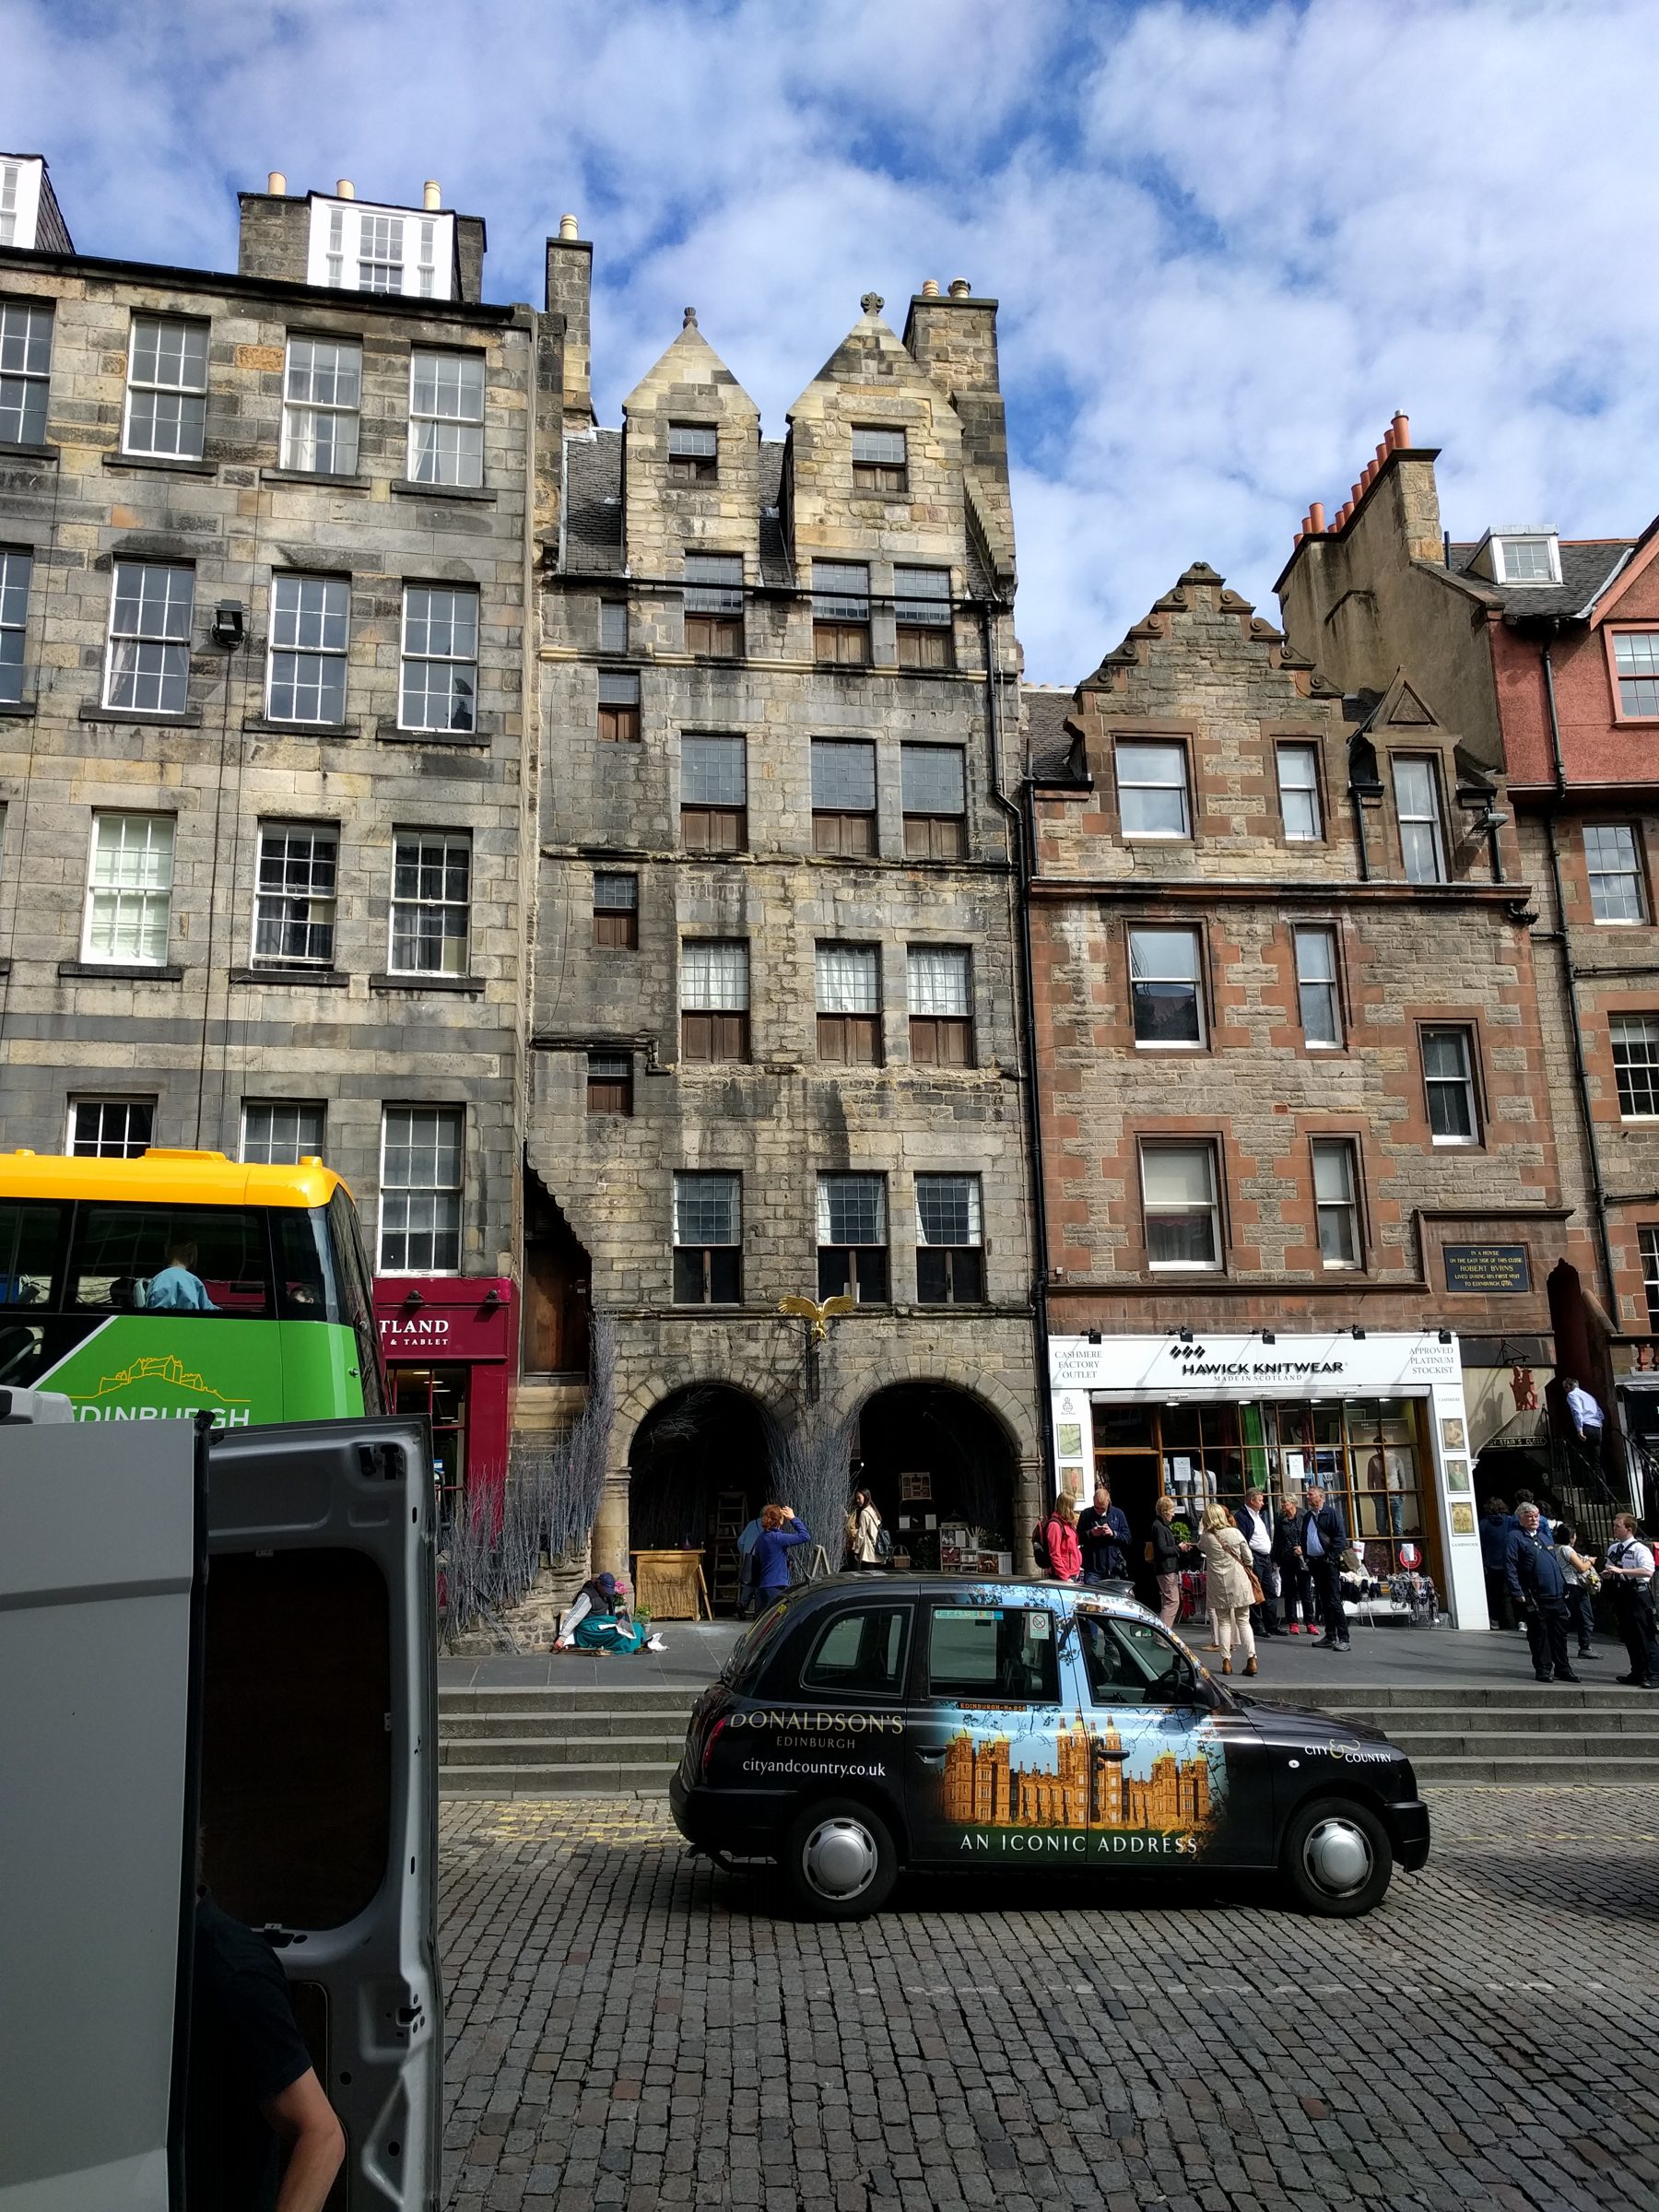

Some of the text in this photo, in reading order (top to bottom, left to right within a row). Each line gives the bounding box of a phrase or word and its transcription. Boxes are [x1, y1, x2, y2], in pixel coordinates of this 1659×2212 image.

[1182, 1363, 1249, 1375] HAWICK
[70, 1405, 250, 1430] DINBUGH
[730, 1711, 903, 1734] DONALDSON'S
[776, 1735, 855, 1748] EDINBURGH
[1304, 1739, 1392, 1762] CITY & COUNTRY
[743, 1757, 887, 1778] cityandcountry.co.uk
[959, 1834, 1197, 1853] AN ICONIC ADDRESS
